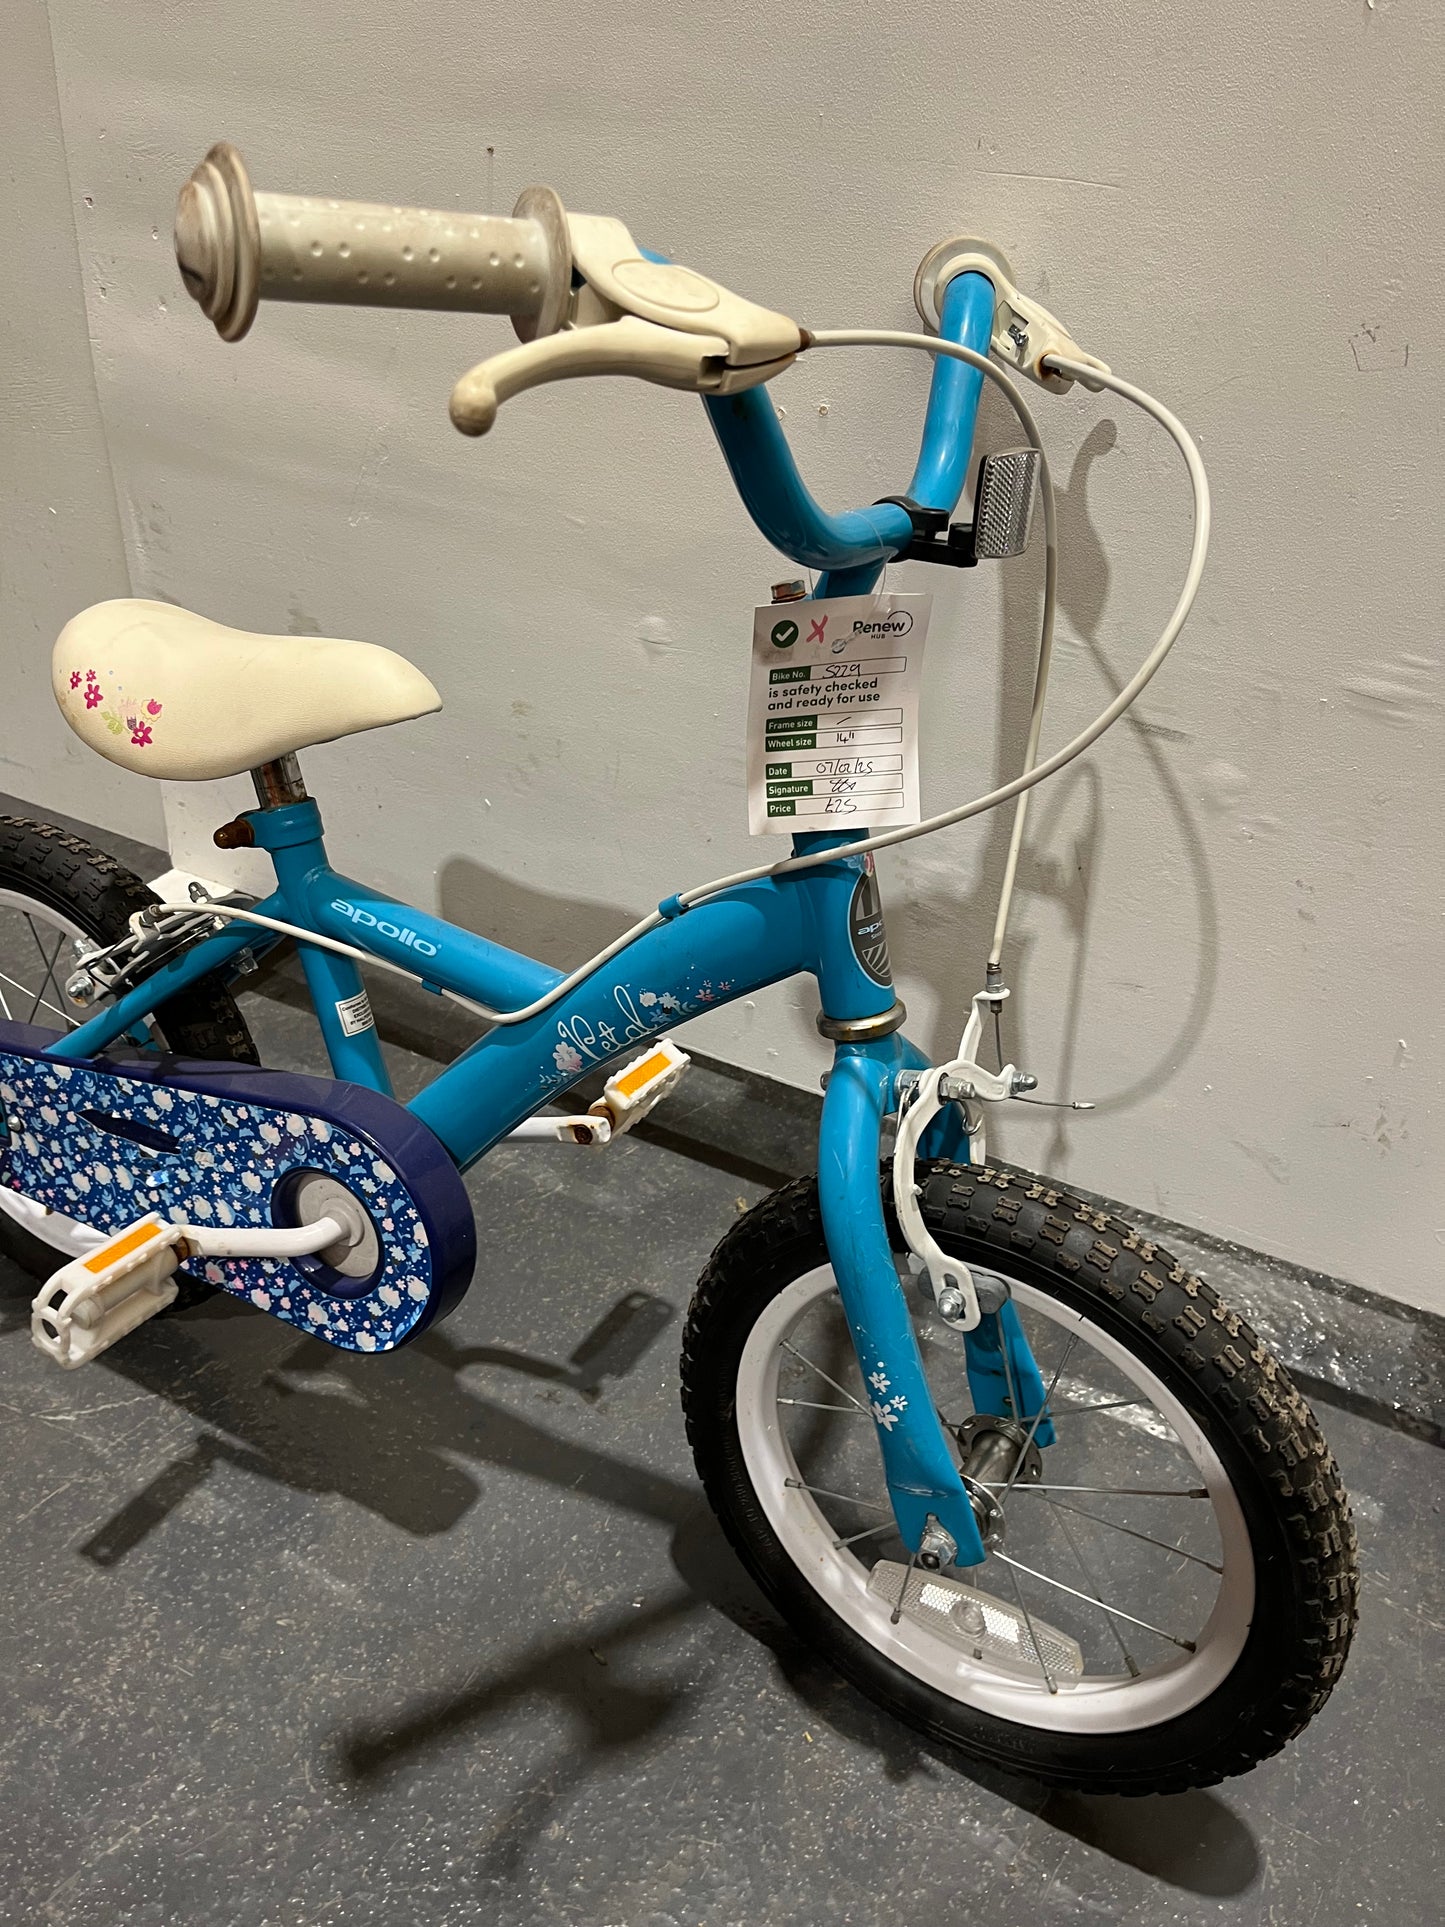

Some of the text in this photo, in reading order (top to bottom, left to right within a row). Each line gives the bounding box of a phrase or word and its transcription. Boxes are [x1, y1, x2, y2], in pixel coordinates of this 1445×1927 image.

[853, 620, 905, 634] Renew
[772, 672, 791, 681] Bike
[792, 670, 806, 679] No.
[768, 677, 878, 698] is safety checked
[768, 693, 880, 711] and ready for use
[768, 722, 795, 730] Frame
[768, 739, 794, 748] Wheel
[796, 737, 812, 746] size
[768, 767, 788, 776] Date
[768, 785, 809, 796] Signature
[769, 805, 791, 813] Price
[330, 898, 437, 956] apollo
[557, 985, 657, 1061] Petal
